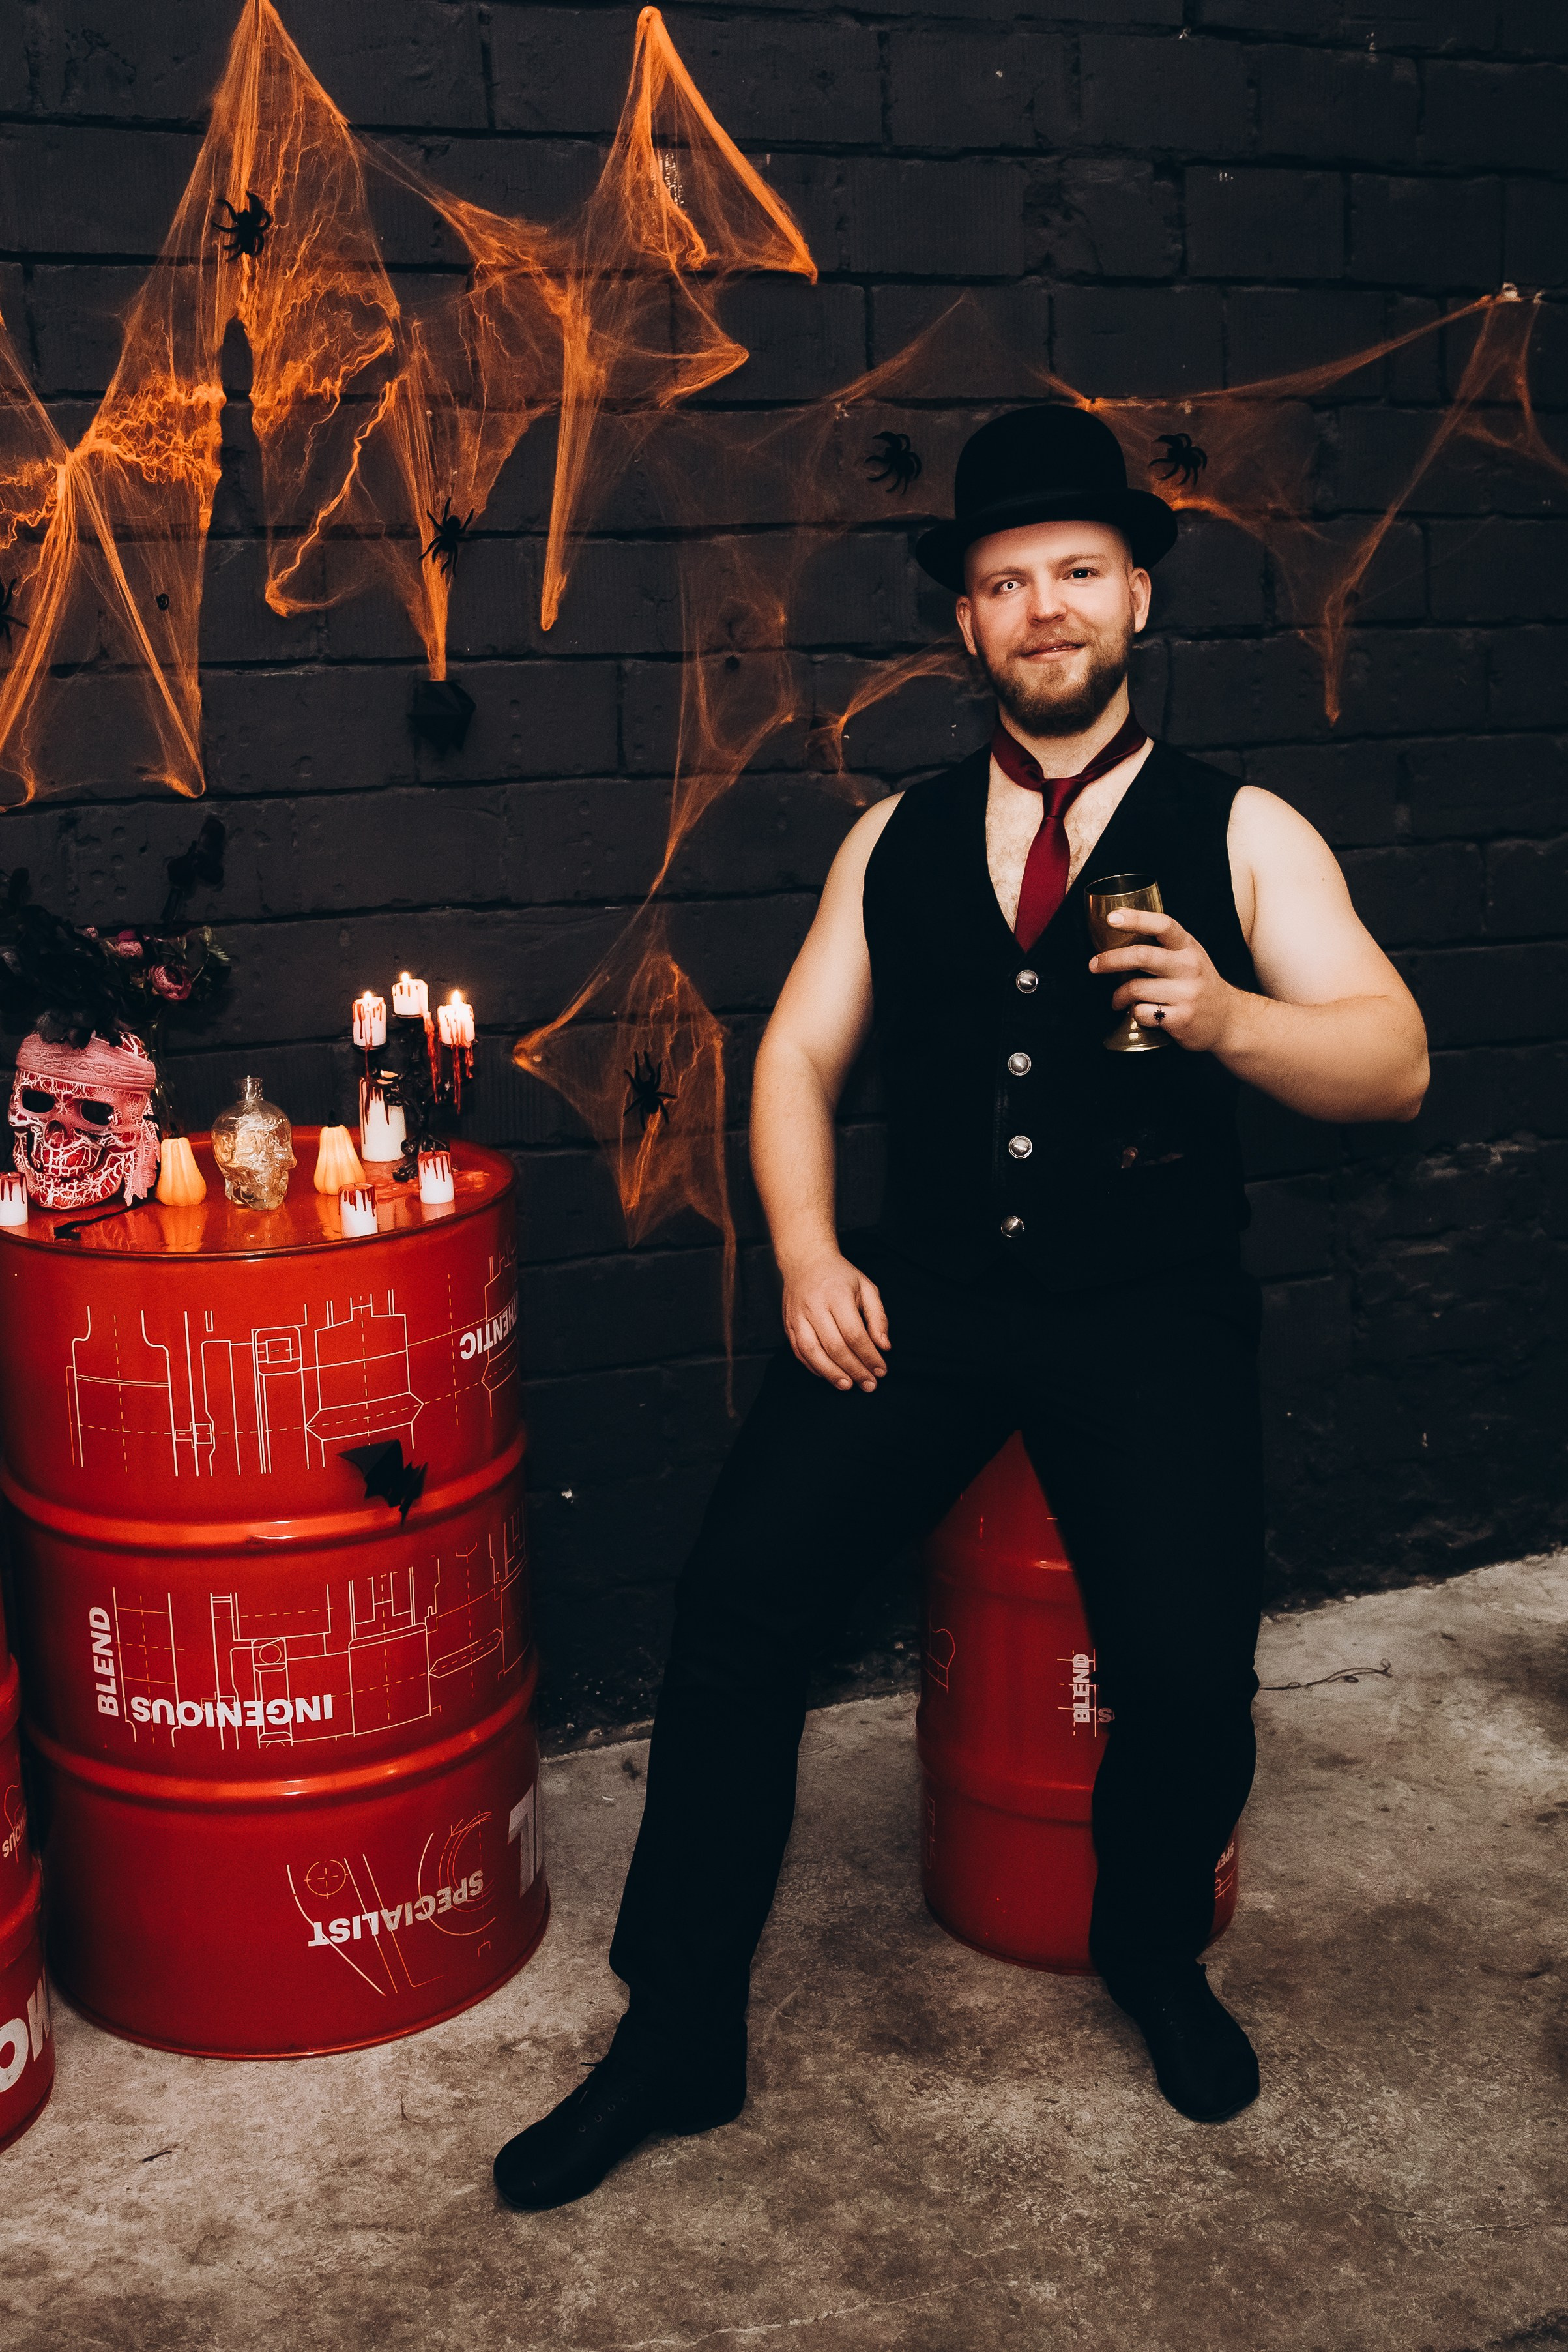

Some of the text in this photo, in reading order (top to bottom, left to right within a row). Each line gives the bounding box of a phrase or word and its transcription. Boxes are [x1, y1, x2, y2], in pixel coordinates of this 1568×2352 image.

[459, 1297, 518, 1360] THENTIC
[89, 1606, 119, 1716] BLEND
[1073, 1653, 1090, 1723] BLEND
[131, 1694, 333, 1727] INGENIOUS
[308, 1870, 483, 1947] SPECIALIST
